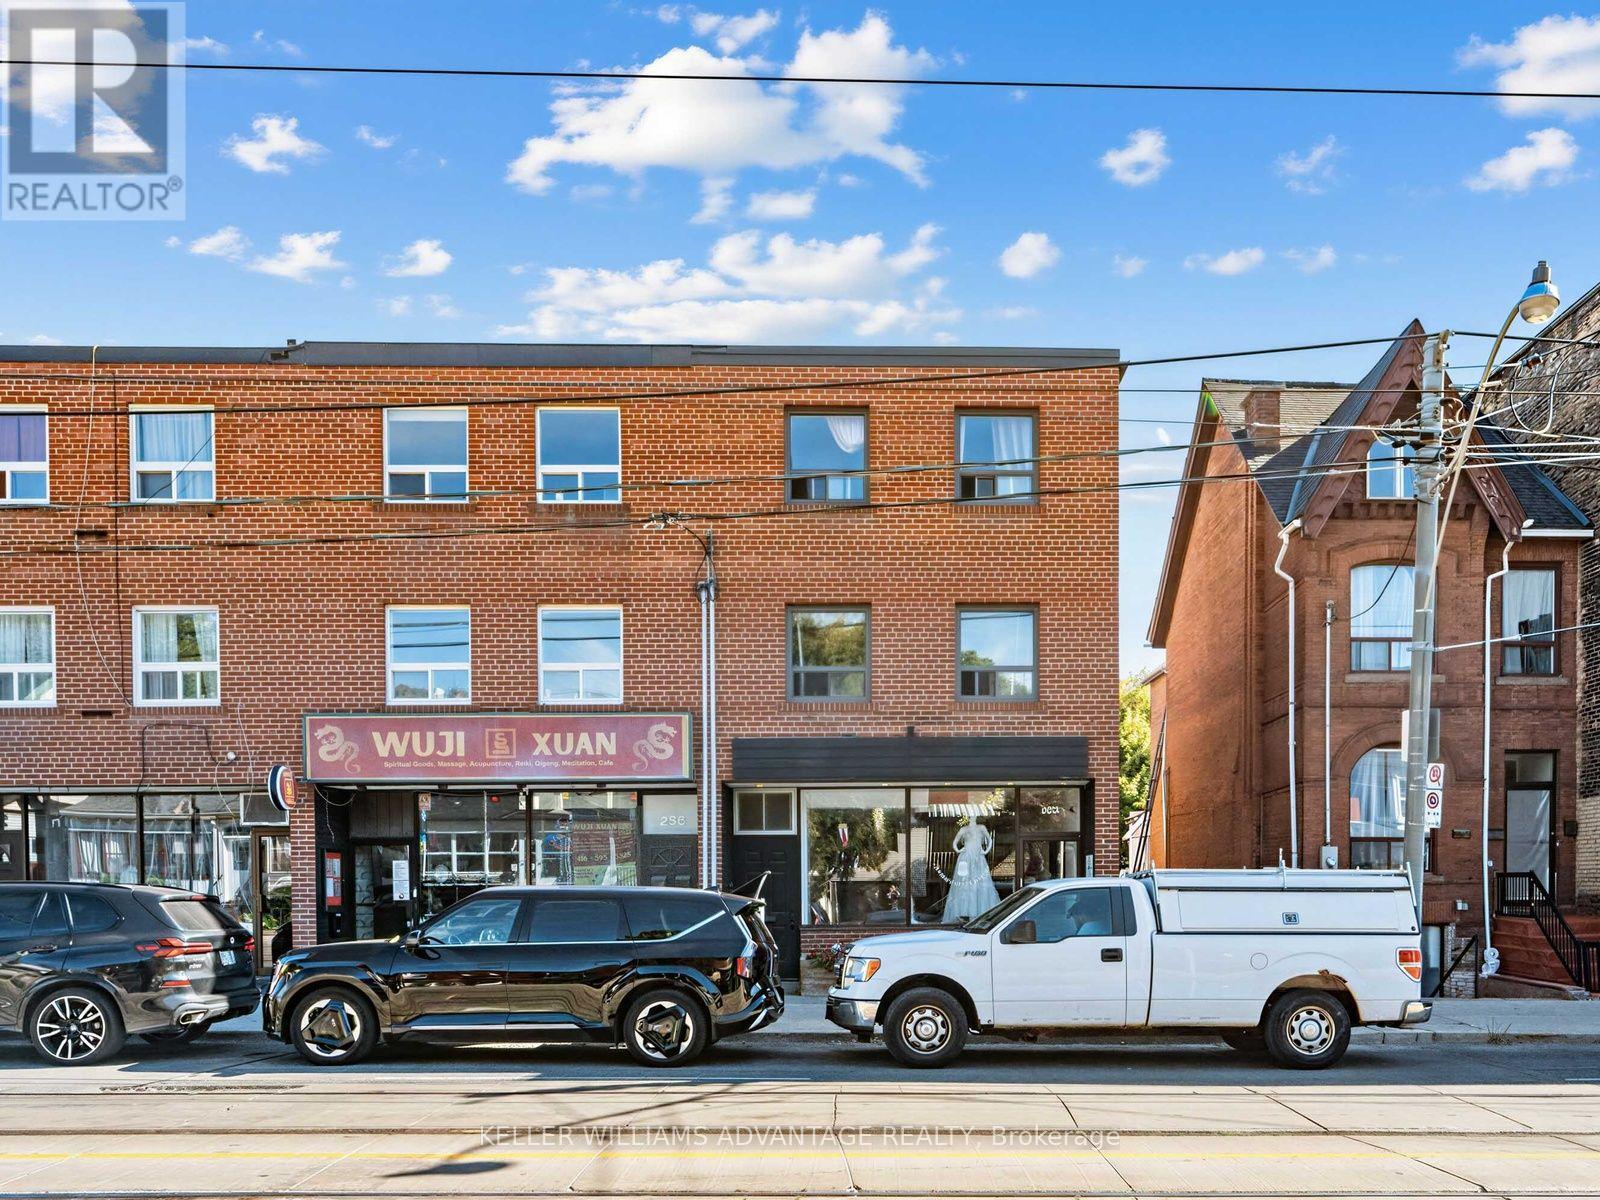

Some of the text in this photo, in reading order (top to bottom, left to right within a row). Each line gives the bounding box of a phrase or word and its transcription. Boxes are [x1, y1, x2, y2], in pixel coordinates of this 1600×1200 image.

[371, 731, 617, 757] WUJI XUAN
[469, 760, 514, 768] Acupuncture,
